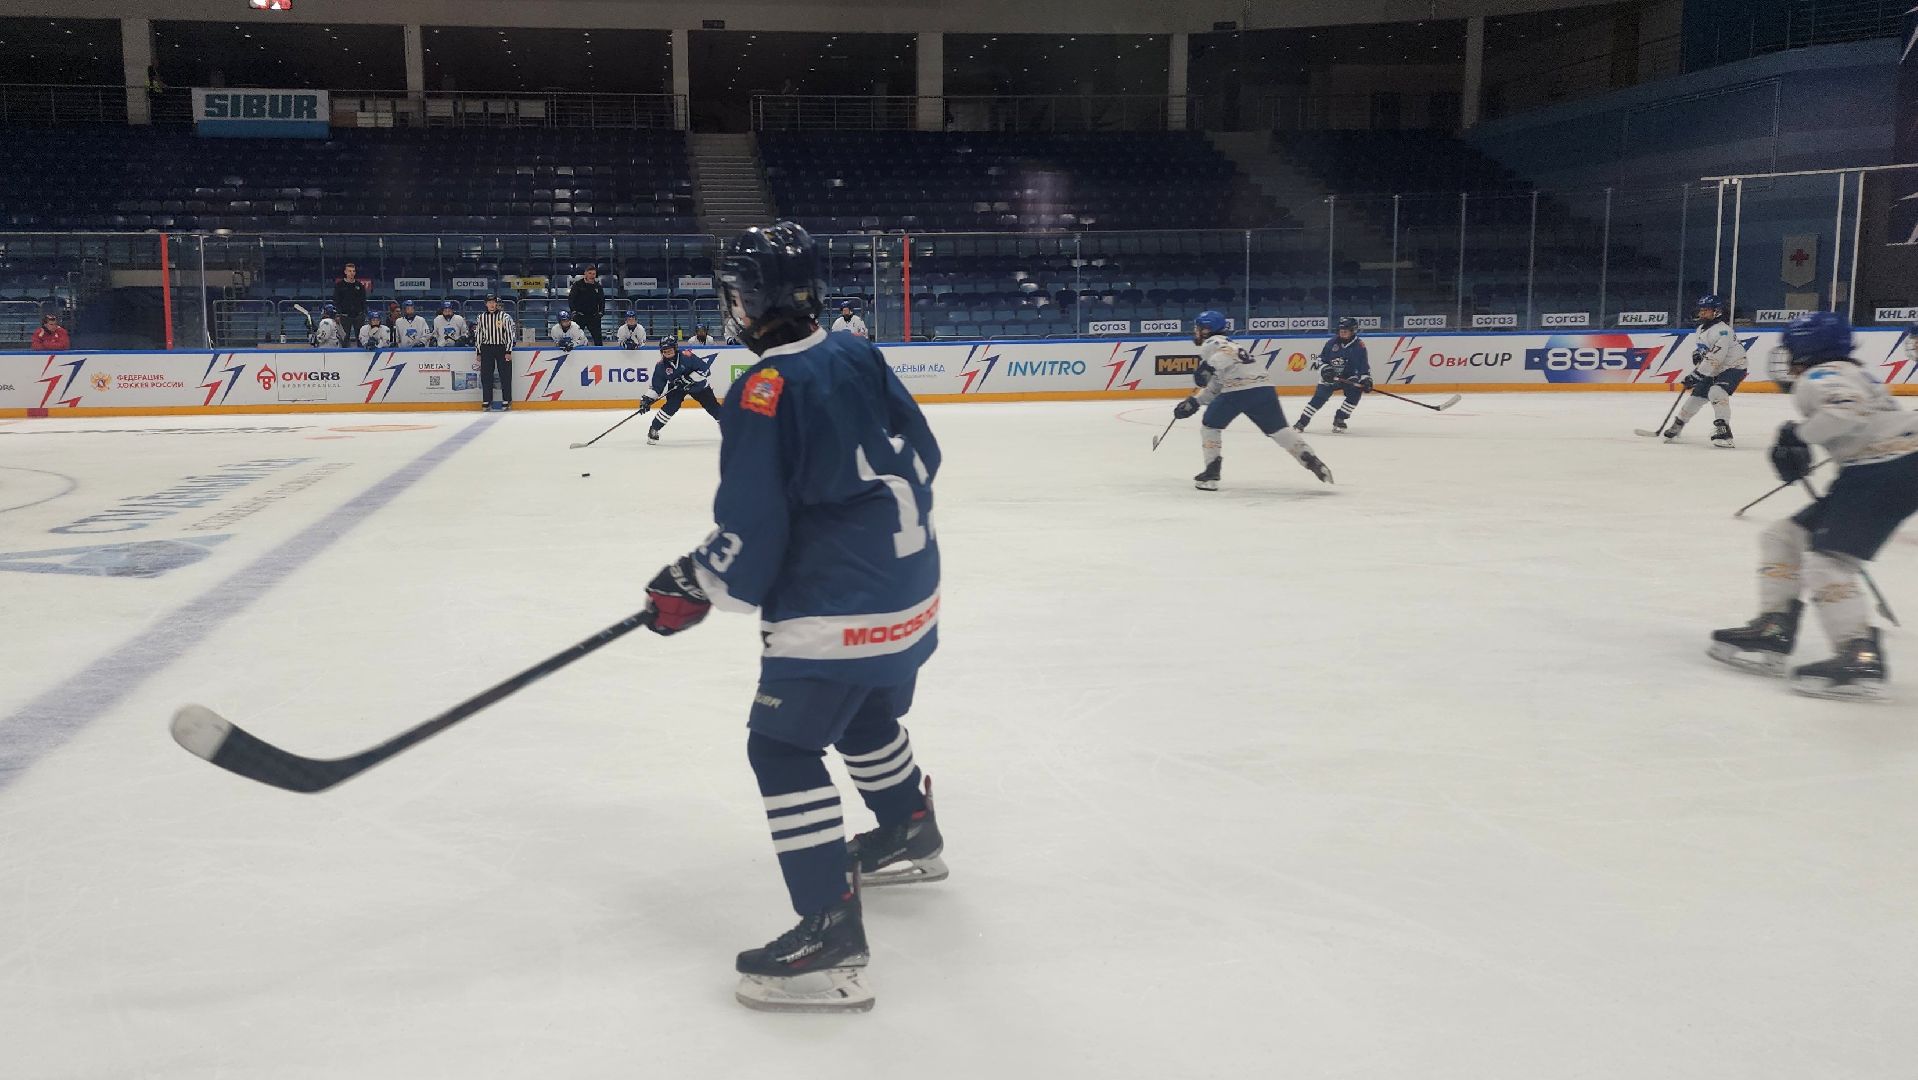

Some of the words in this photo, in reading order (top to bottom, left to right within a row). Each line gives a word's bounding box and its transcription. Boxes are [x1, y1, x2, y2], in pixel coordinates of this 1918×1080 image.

[204, 94, 318, 119] SIBUR
[1546, 314, 1586, 324] согаз
[1621, 313, 1665, 323] KHL.RU
[1879, 310, 1918, 319] KHL.R
[1252, 319, 1286, 328] согаз
[1292, 318, 1326, 327] согаз
[1358, 318, 1378, 327] газ
[1407, 317, 1444, 326] согаз
[1476, 315, 1514, 325] согаз
[1092, 323, 1126, 331] согаз
[1144, 322, 1178, 331] согаз
[1546, 347, 1628, 371] 895
[1007, 360, 1086, 377] INVITRO
[281, 371, 341, 381] OVIGR8
[608, 367, 650, 383] ПСБ
[117, 381, 150, 389] ХОККЕЯ
